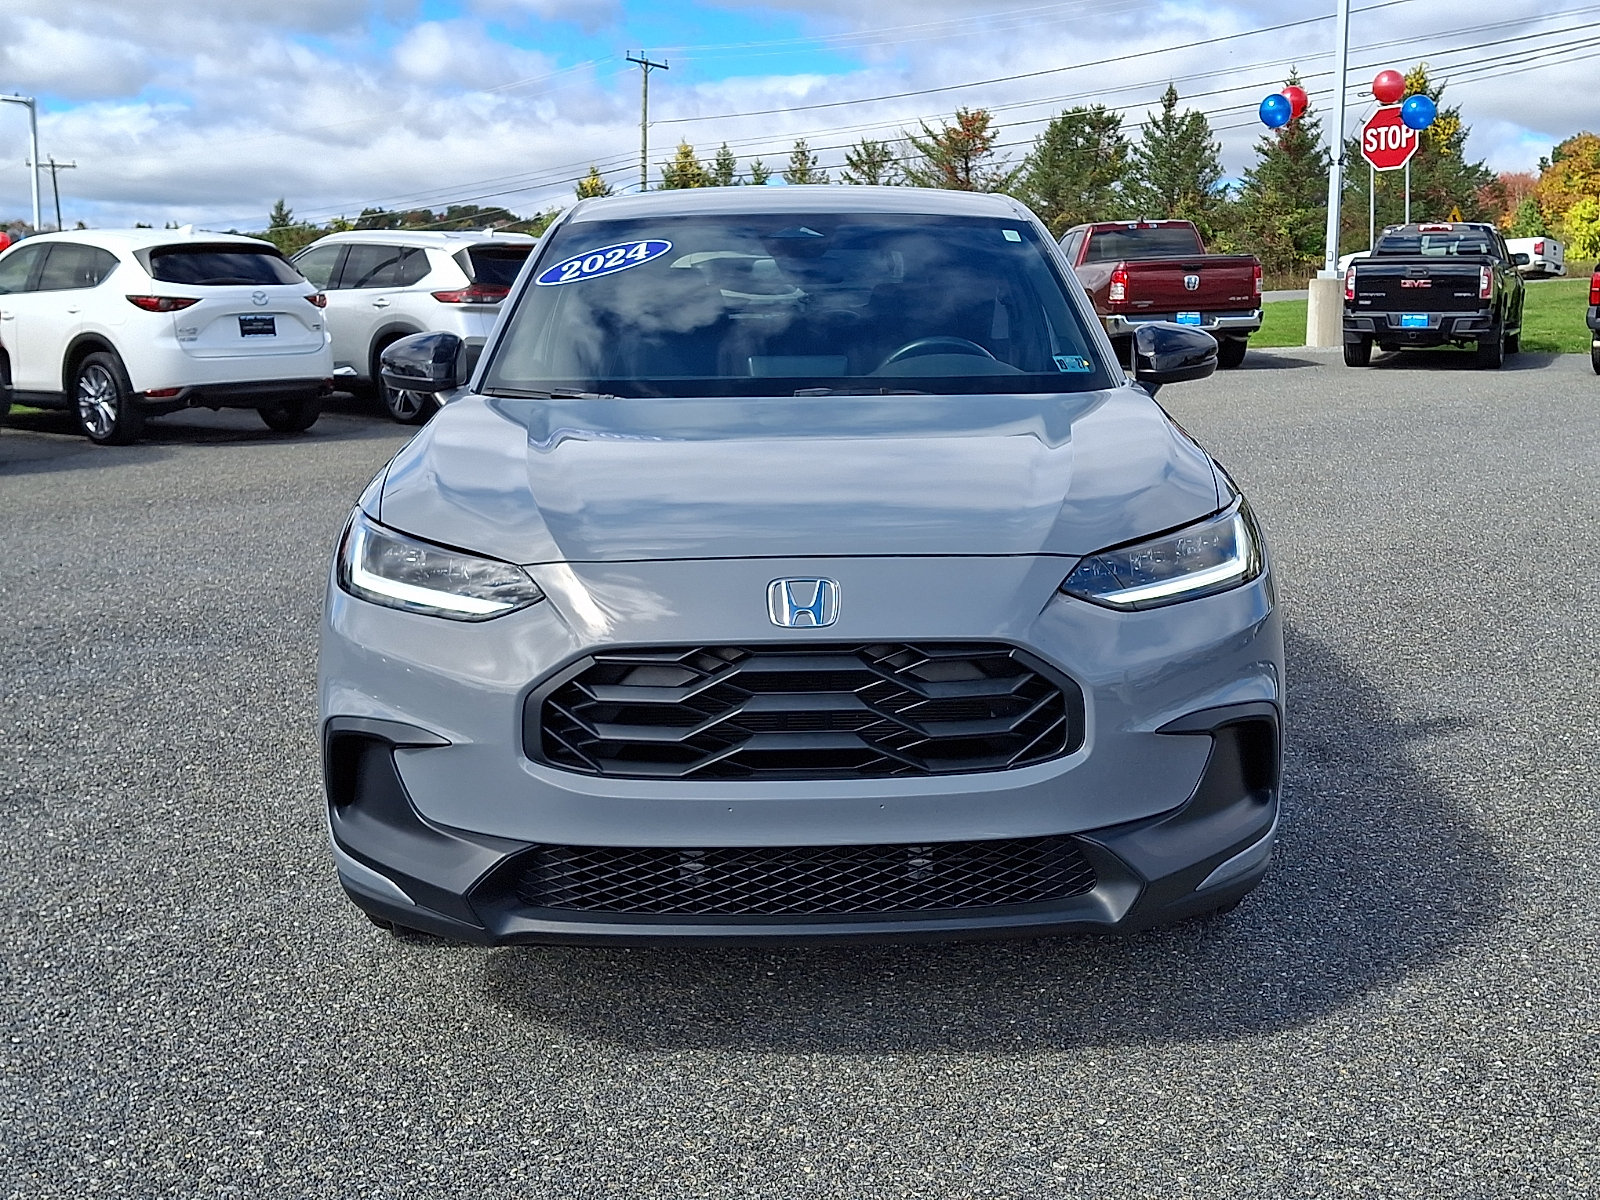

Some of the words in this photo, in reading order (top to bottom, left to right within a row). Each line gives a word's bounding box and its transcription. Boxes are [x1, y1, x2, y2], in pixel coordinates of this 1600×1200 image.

[1364, 124, 1415, 153] STOP
[559, 242, 651, 282] 2024
[1400, 279, 1433, 288] GMC
